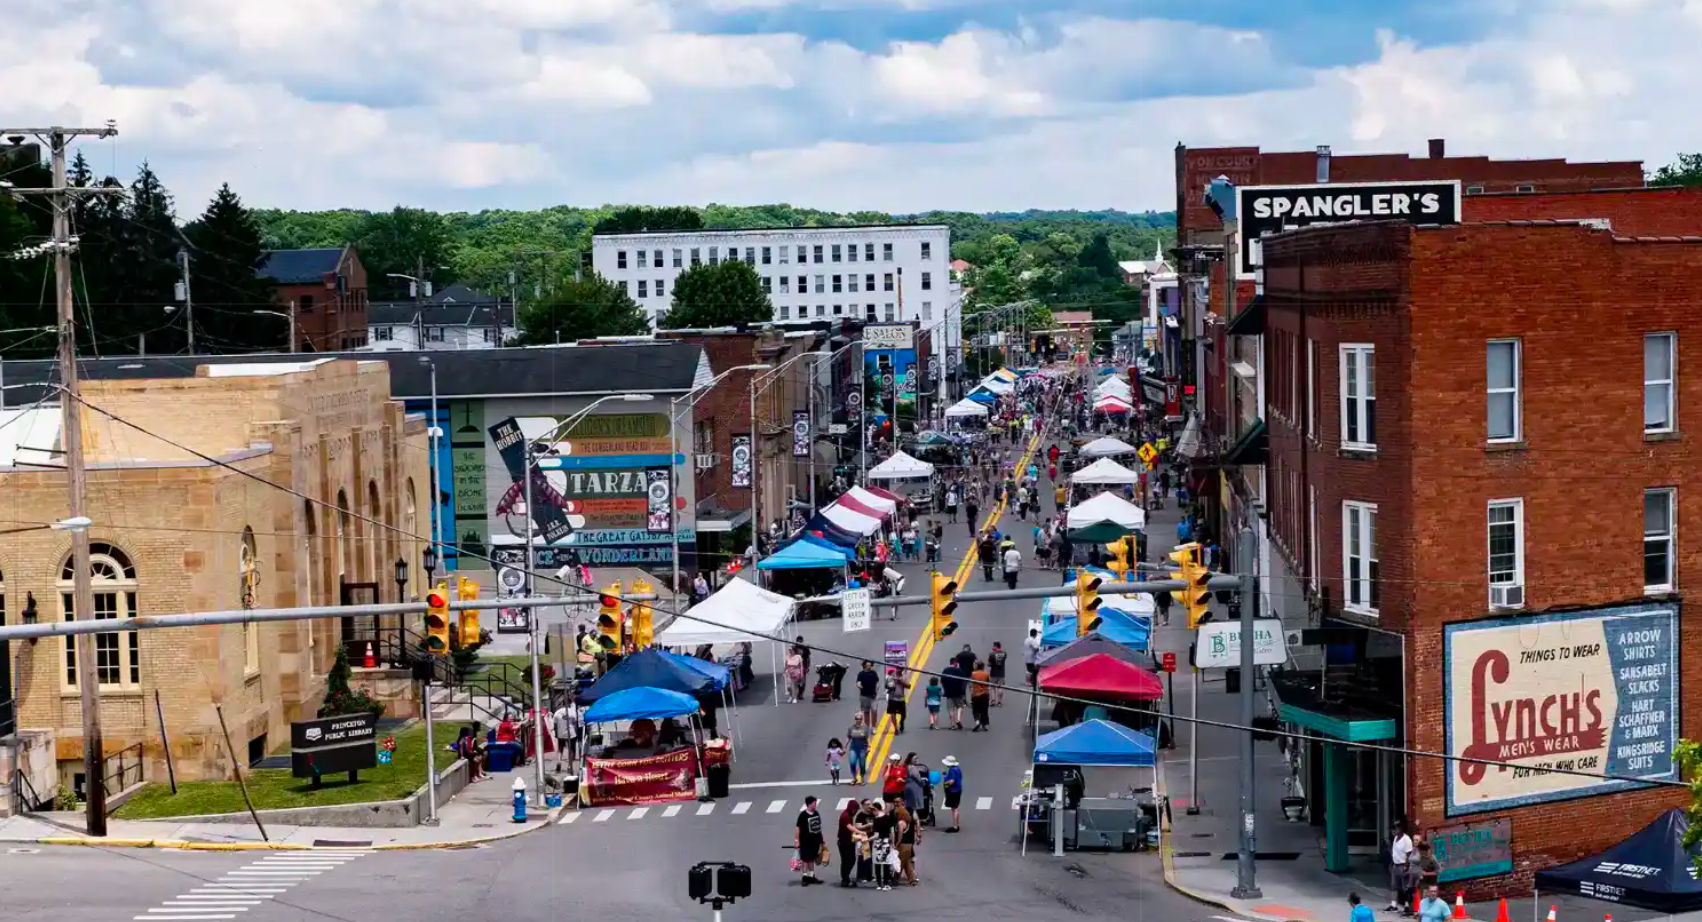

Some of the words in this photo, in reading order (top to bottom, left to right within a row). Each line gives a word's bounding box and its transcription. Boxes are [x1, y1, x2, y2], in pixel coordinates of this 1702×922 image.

[1253, 193, 1440, 219] SPANGLER'S
[497, 423, 514, 438] THE
[495, 430, 523, 451] HOBBIT
[570, 472, 648, 493] TARZA
[575, 531, 594, 543] THE
[596, 530, 625, 543] GREAT
[577, 547, 674, 563] WONDERLAND
[1619, 629, 1661, 645] ARROW
[1520, 649, 1556, 664] THINGS
[1559, 647, 1570, 660] TO
[1573, 643, 1601, 658] WEAR
[1623, 645, 1656, 661] SHIRTS
[1620, 663, 1667, 681] SANSABELT
[1628, 679, 1660, 695] SLACKS
[1631, 699, 1655, 713] HART
[331, 720, 366, 730] PRINCETON
[1619, 710, 1665, 728] SCHAFFNER
[324, 732, 345, 741] PUBLIC
[348, 728, 373, 737] LIBRARY
[1632, 724, 1659, 739] MARX
[1543, 735, 1580, 752] WEAR
[1617, 740, 1666, 759] KINGSRIDGE
[1513, 765, 1530, 779] FOR
[1532, 762, 1553, 777] MEN
[1556, 759, 1575, 772] WHO
[1577, 756, 1599, 769] CARE
[1628, 755, 1654, 770] SUITS
